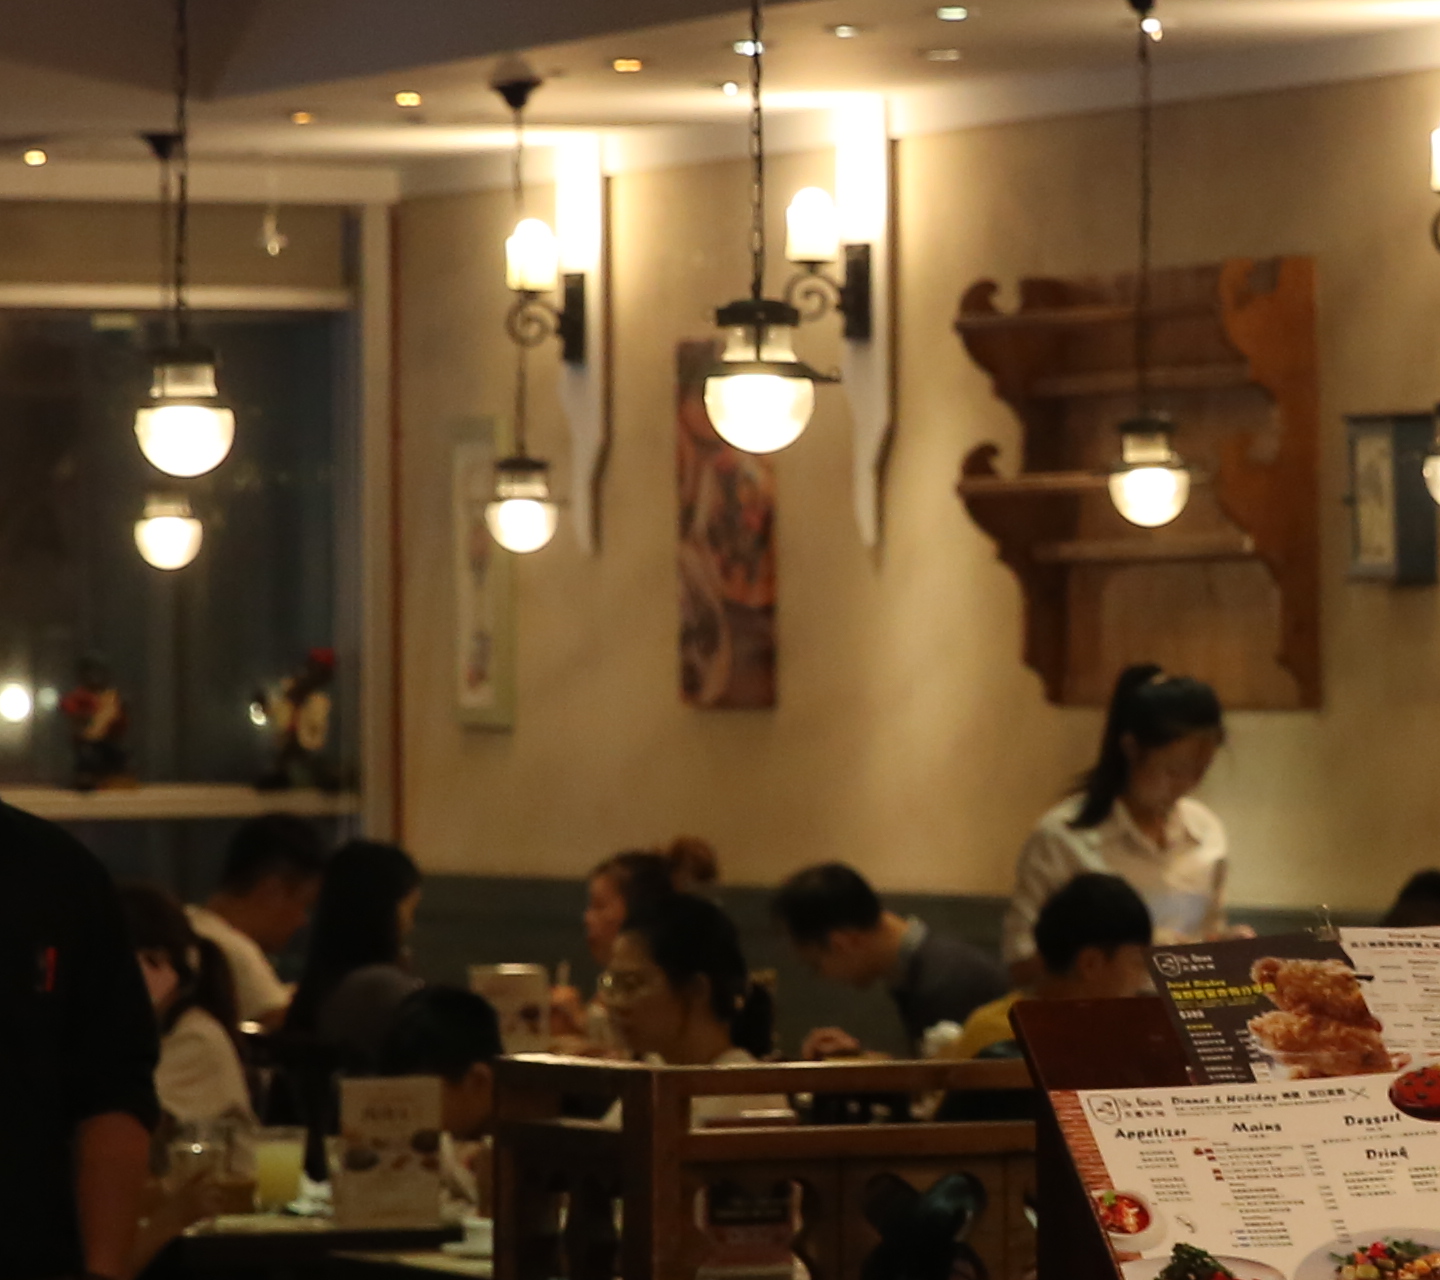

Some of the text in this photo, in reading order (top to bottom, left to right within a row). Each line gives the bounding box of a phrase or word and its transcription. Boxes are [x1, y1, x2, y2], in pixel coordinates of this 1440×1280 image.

[1343, 1112, 1401, 1127] Dessert
[1231, 1121, 1282, 1134] Mains
[1365, 1147, 1409, 1161] Drink
